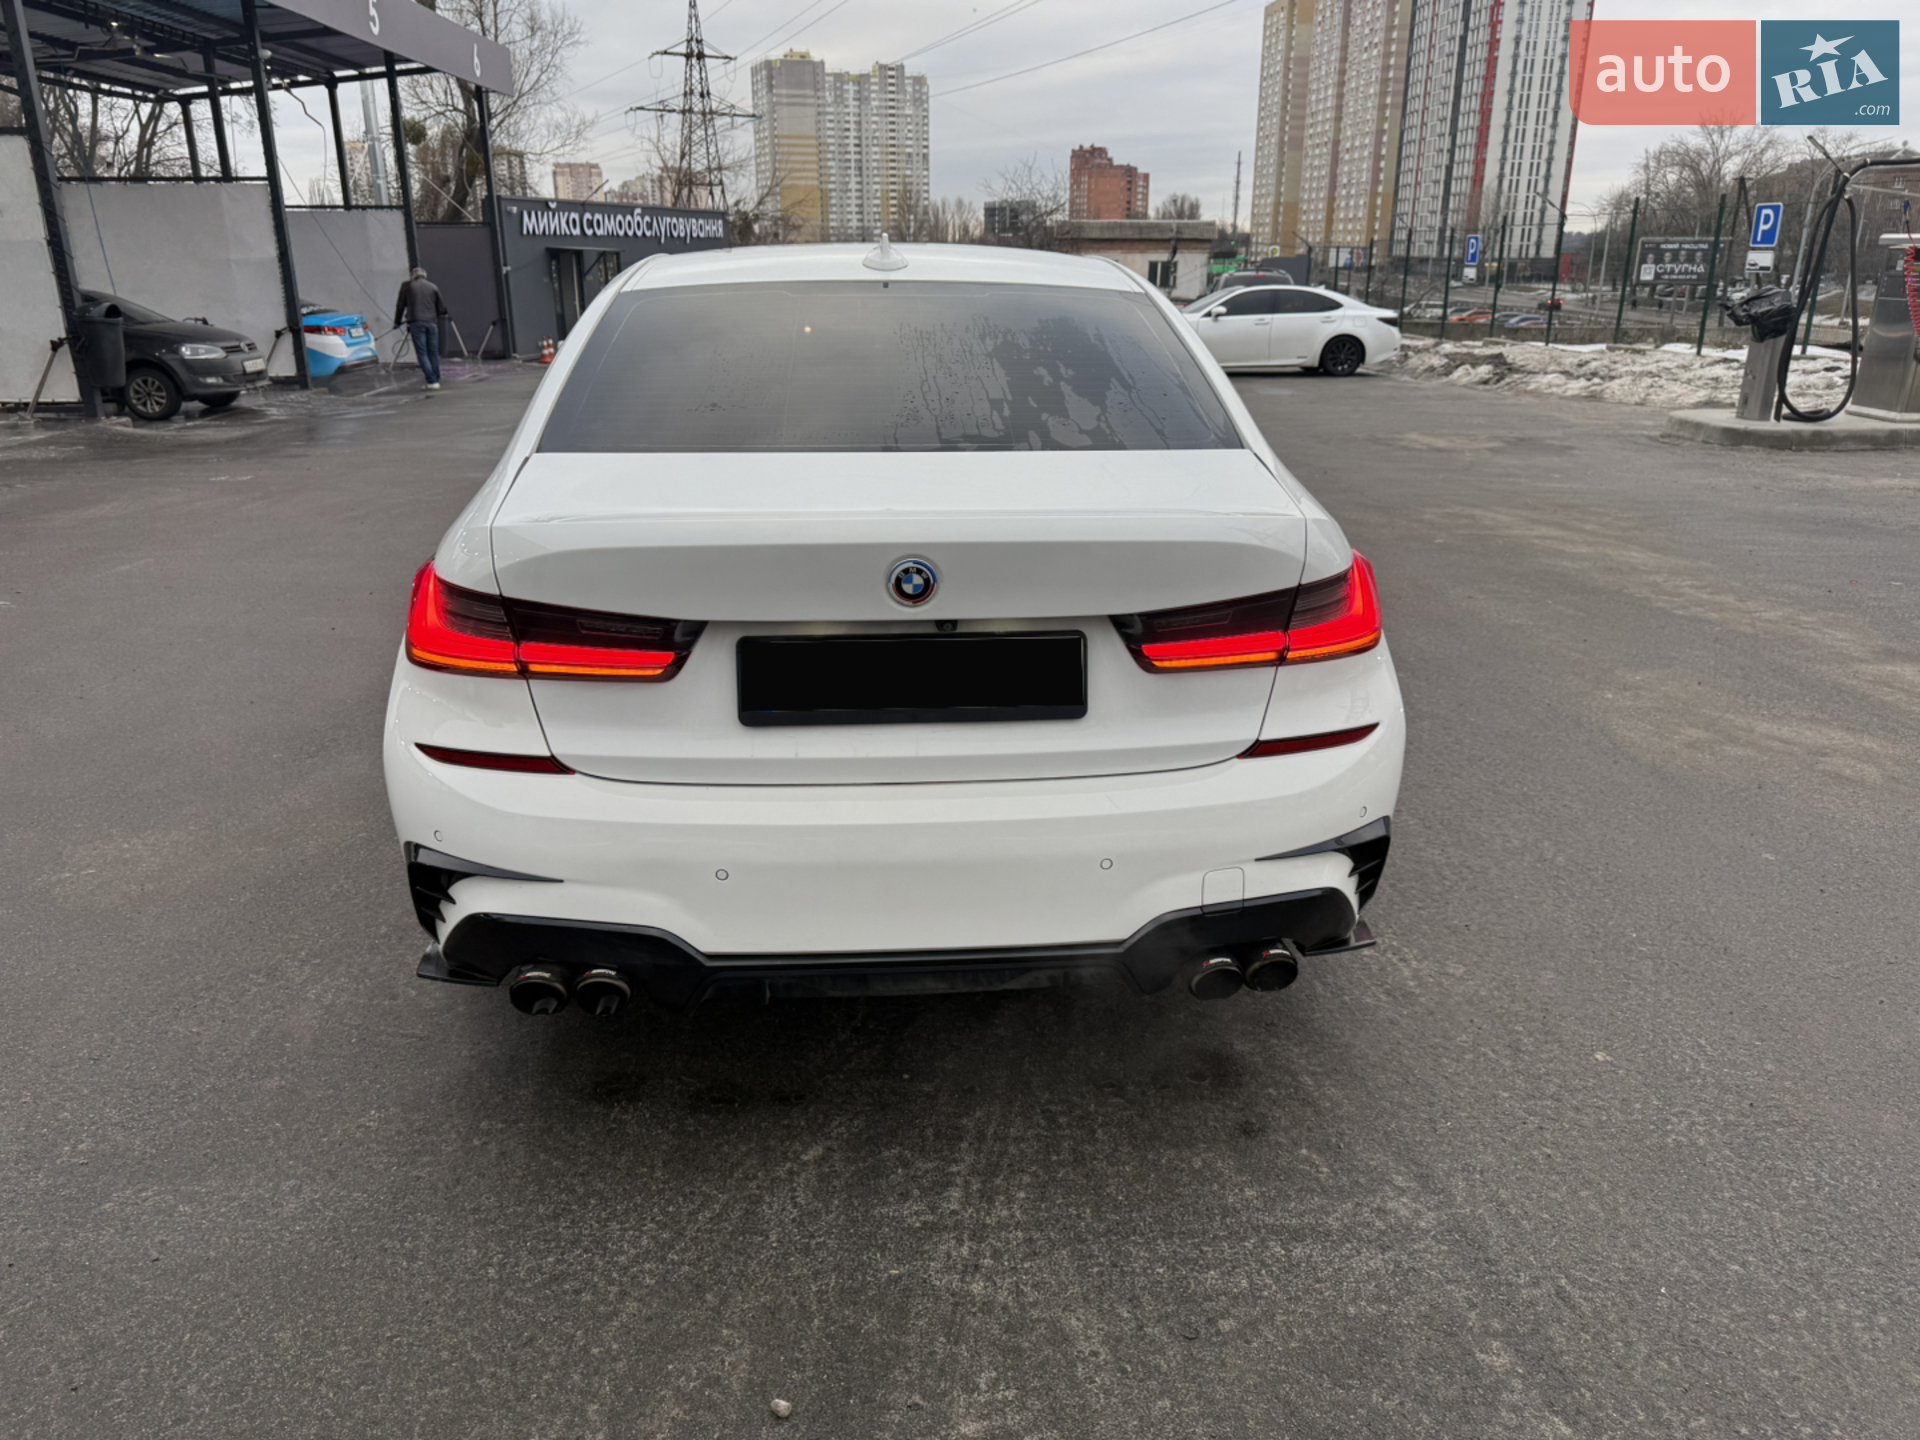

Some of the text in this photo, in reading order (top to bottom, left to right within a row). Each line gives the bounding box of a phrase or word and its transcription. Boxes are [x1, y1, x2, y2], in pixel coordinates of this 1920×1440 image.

[368, 0, 380, 36] 5
[473, 42, 481, 78] 6
[1757, 208, 1774, 243] P
[1468, 239, 1477, 260] P
